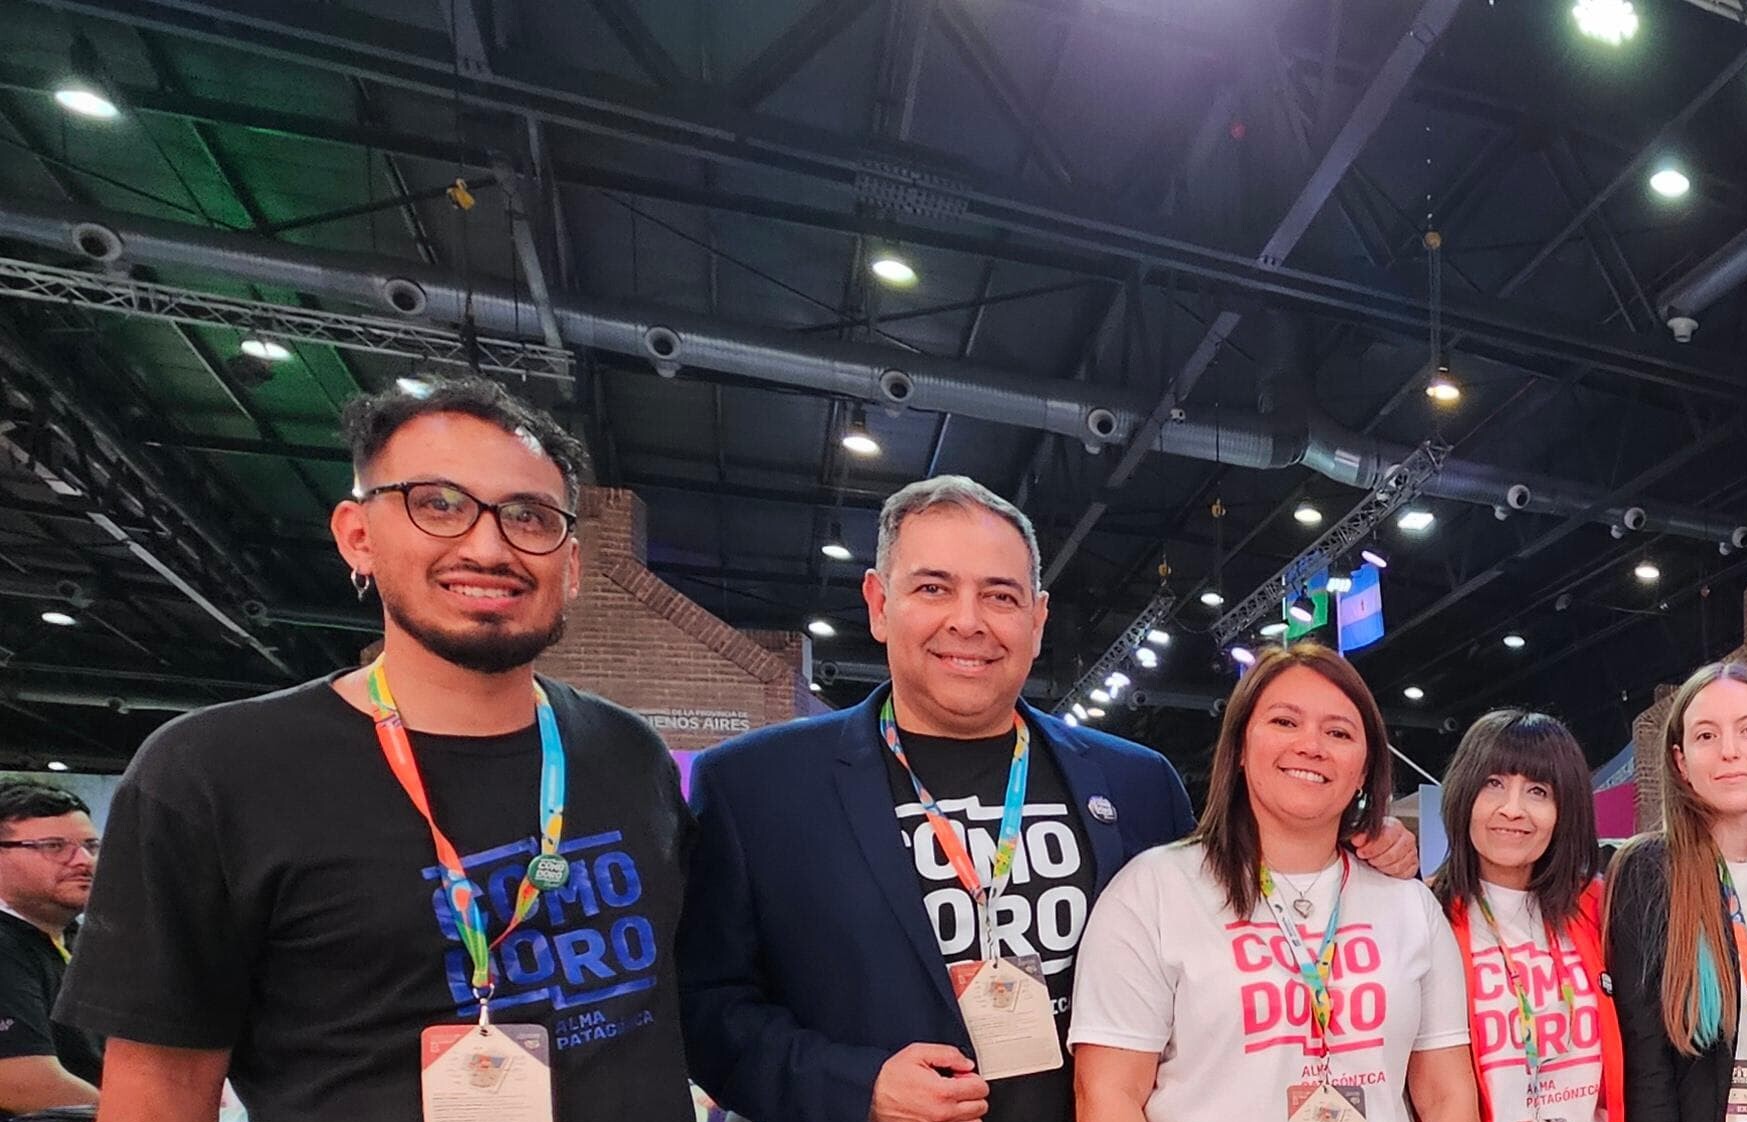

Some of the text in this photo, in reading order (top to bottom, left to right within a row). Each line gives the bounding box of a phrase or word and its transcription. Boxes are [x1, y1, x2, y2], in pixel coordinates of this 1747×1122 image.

[650, 715, 750, 731] ENOS AIRES
[901, 821, 1081, 884] OMO
[923, 885, 1087, 960] ORO
[444, 916, 657, 1004] DORO
[1475, 961, 1594, 1008] COMO
[555, 1010, 606, 1034] ALMA
[556, 1010, 654, 1050] PATAGCA
[1241, 978, 1387, 1039] DORO
[1475, 1005, 1600, 1057] DORO
[1302, 1072, 1386, 1089] PATGÓNICA
